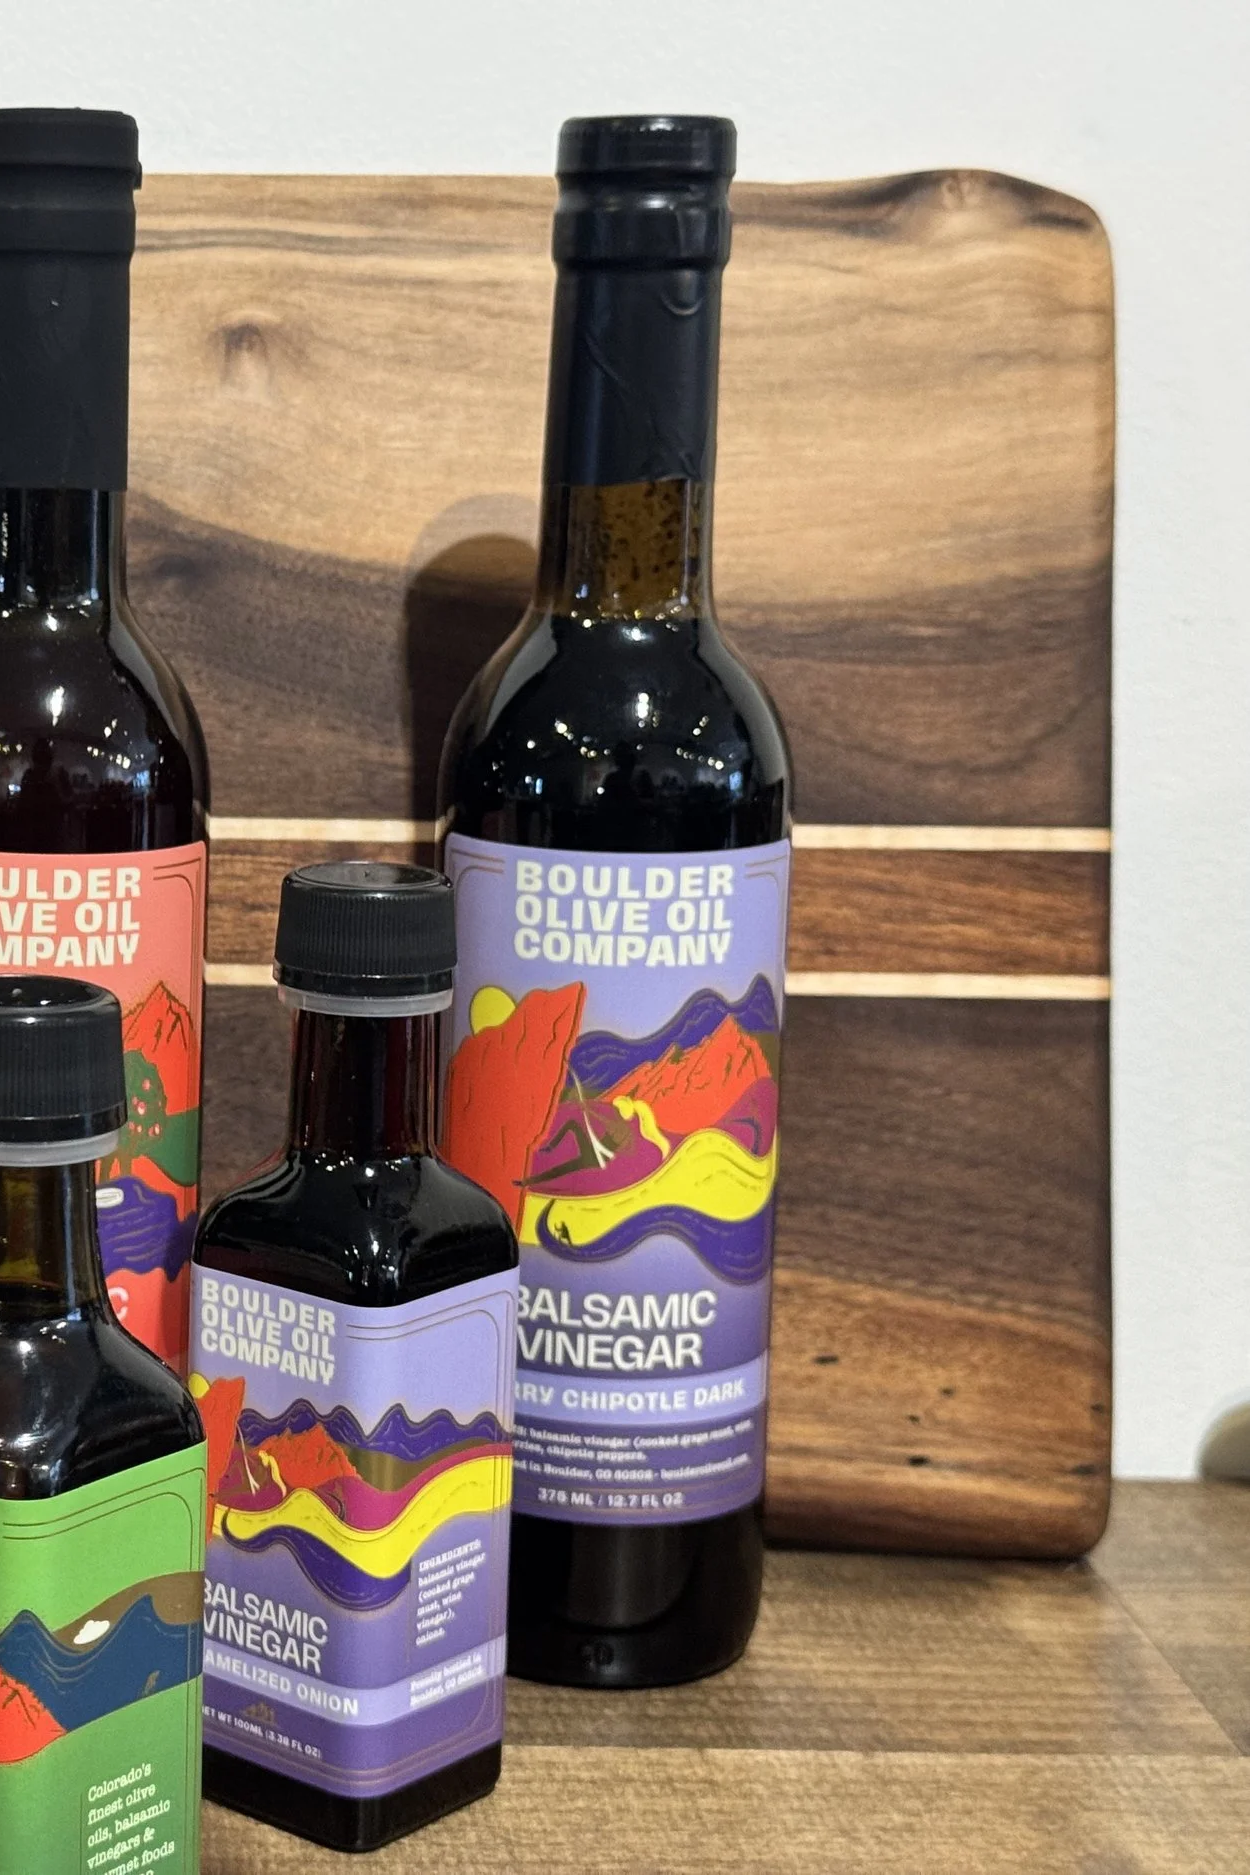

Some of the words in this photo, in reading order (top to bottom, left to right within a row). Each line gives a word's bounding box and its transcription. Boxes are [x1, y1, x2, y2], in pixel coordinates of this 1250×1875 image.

[516, 860, 734, 899] BOULDER
[74, 900, 141, 934] OIL
[515, 894, 650, 933] OLIVE
[666, 899, 732, 932] OIL
[514, 928, 731, 967] COMPANY
[201, 1277, 336, 1336] BOULDER
[201, 1303, 282, 1346] OLIVE
[291, 1329, 335, 1362] OIL
[517, 1325, 702, 1370] VINEGAR
[201, 1328, 335, 1386] COMPANY
[562, 1388, 687, 1411] CHIPOTLE
[693, 1378, 745, 1406] DARK
[203, 1610, 321, 1675] VINEGAR
[217, 1711, 232, 1723] WT
[297, 1684, 359, 1716] ONION
[88, 1763, 152, 1802] Colorado's
[87, 1797, 124, 1825] finest
[126, 1784, 156, 1806] olive
[87, 1827, 112, 1848] oils,
[114, 1800, 170, 1834] balsamic
[87, 1834, 140, 1869] vinegars
[143, 1827, 155, 1842] &
[141, 1841, 175, 1866] foods
